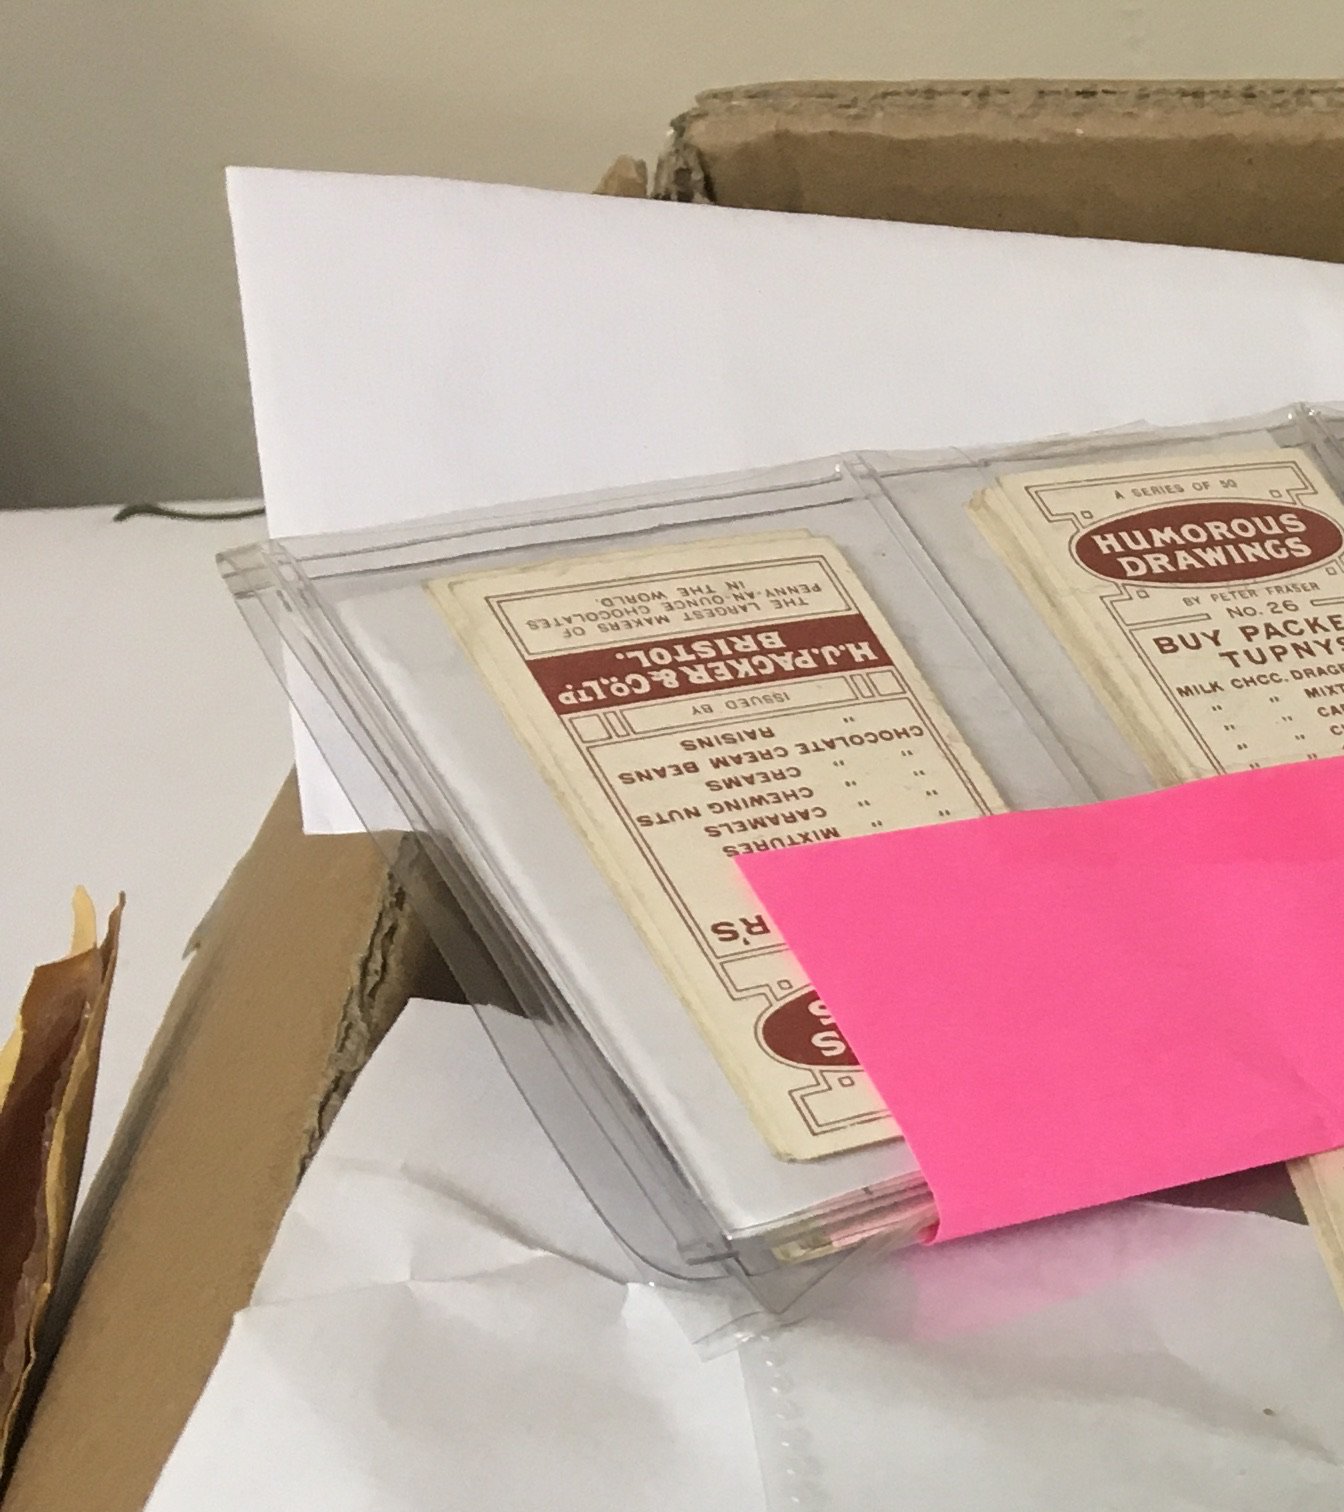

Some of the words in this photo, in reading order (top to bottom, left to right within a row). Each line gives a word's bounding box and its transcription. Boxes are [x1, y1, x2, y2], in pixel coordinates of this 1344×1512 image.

[1114, 490, 1123, 499] A
[1132, 482, 1184, 498] SERIES
[1194, 480, 1210, 492] OF
[1220, 478, 1237, 488] 50
[1091, 513, 1307, 555] HUMOROUS
[1117, 537, 1312, 577] DRAWINGS
[676, 584, 711, 597] THE
[726, 580, 744, 591] IN
[1183, 596, 1200, 607] BY
[1211, 588, 1258, 603] PETER
[1266, 581, 1320, 597] FRASER
[595, 590, 664, 606] WORLD.
[770, 597, 808, 609] THE
[1227, 604, 1263, 619] NO.
[1270, 599, 1299, 614] 26
[525, 603, 652, 630] CHOCOLATES
[683, 602, 759, 621] LARGEST
[562, 626, 584, 637] OF
[596, 614, 668, 633] MAKERS
[615, 630, 786, 663] BRISTOL.
[1152, 630, 1221, 654] BUY
[725, 691, 790, 709] ISSUED
[1177, 681, 1223, 698] MILK
[690, 703, 712, 715] BY
[680, 726, 774, 751] RAISINS
[795, 724, 923, 755] CHOCOLATE
[709, 746, 788, 769] CREAM
[618, 761, 699, 784] BEANS
[704, 766, 801, 791] CREAMS
[708, 787, 813, 814] CHEWING
[635, 805, 699, 827] NUTS
[703, 806, 827, 837] CARAMELS
[722, 826, 839, 857] MIXTURES
